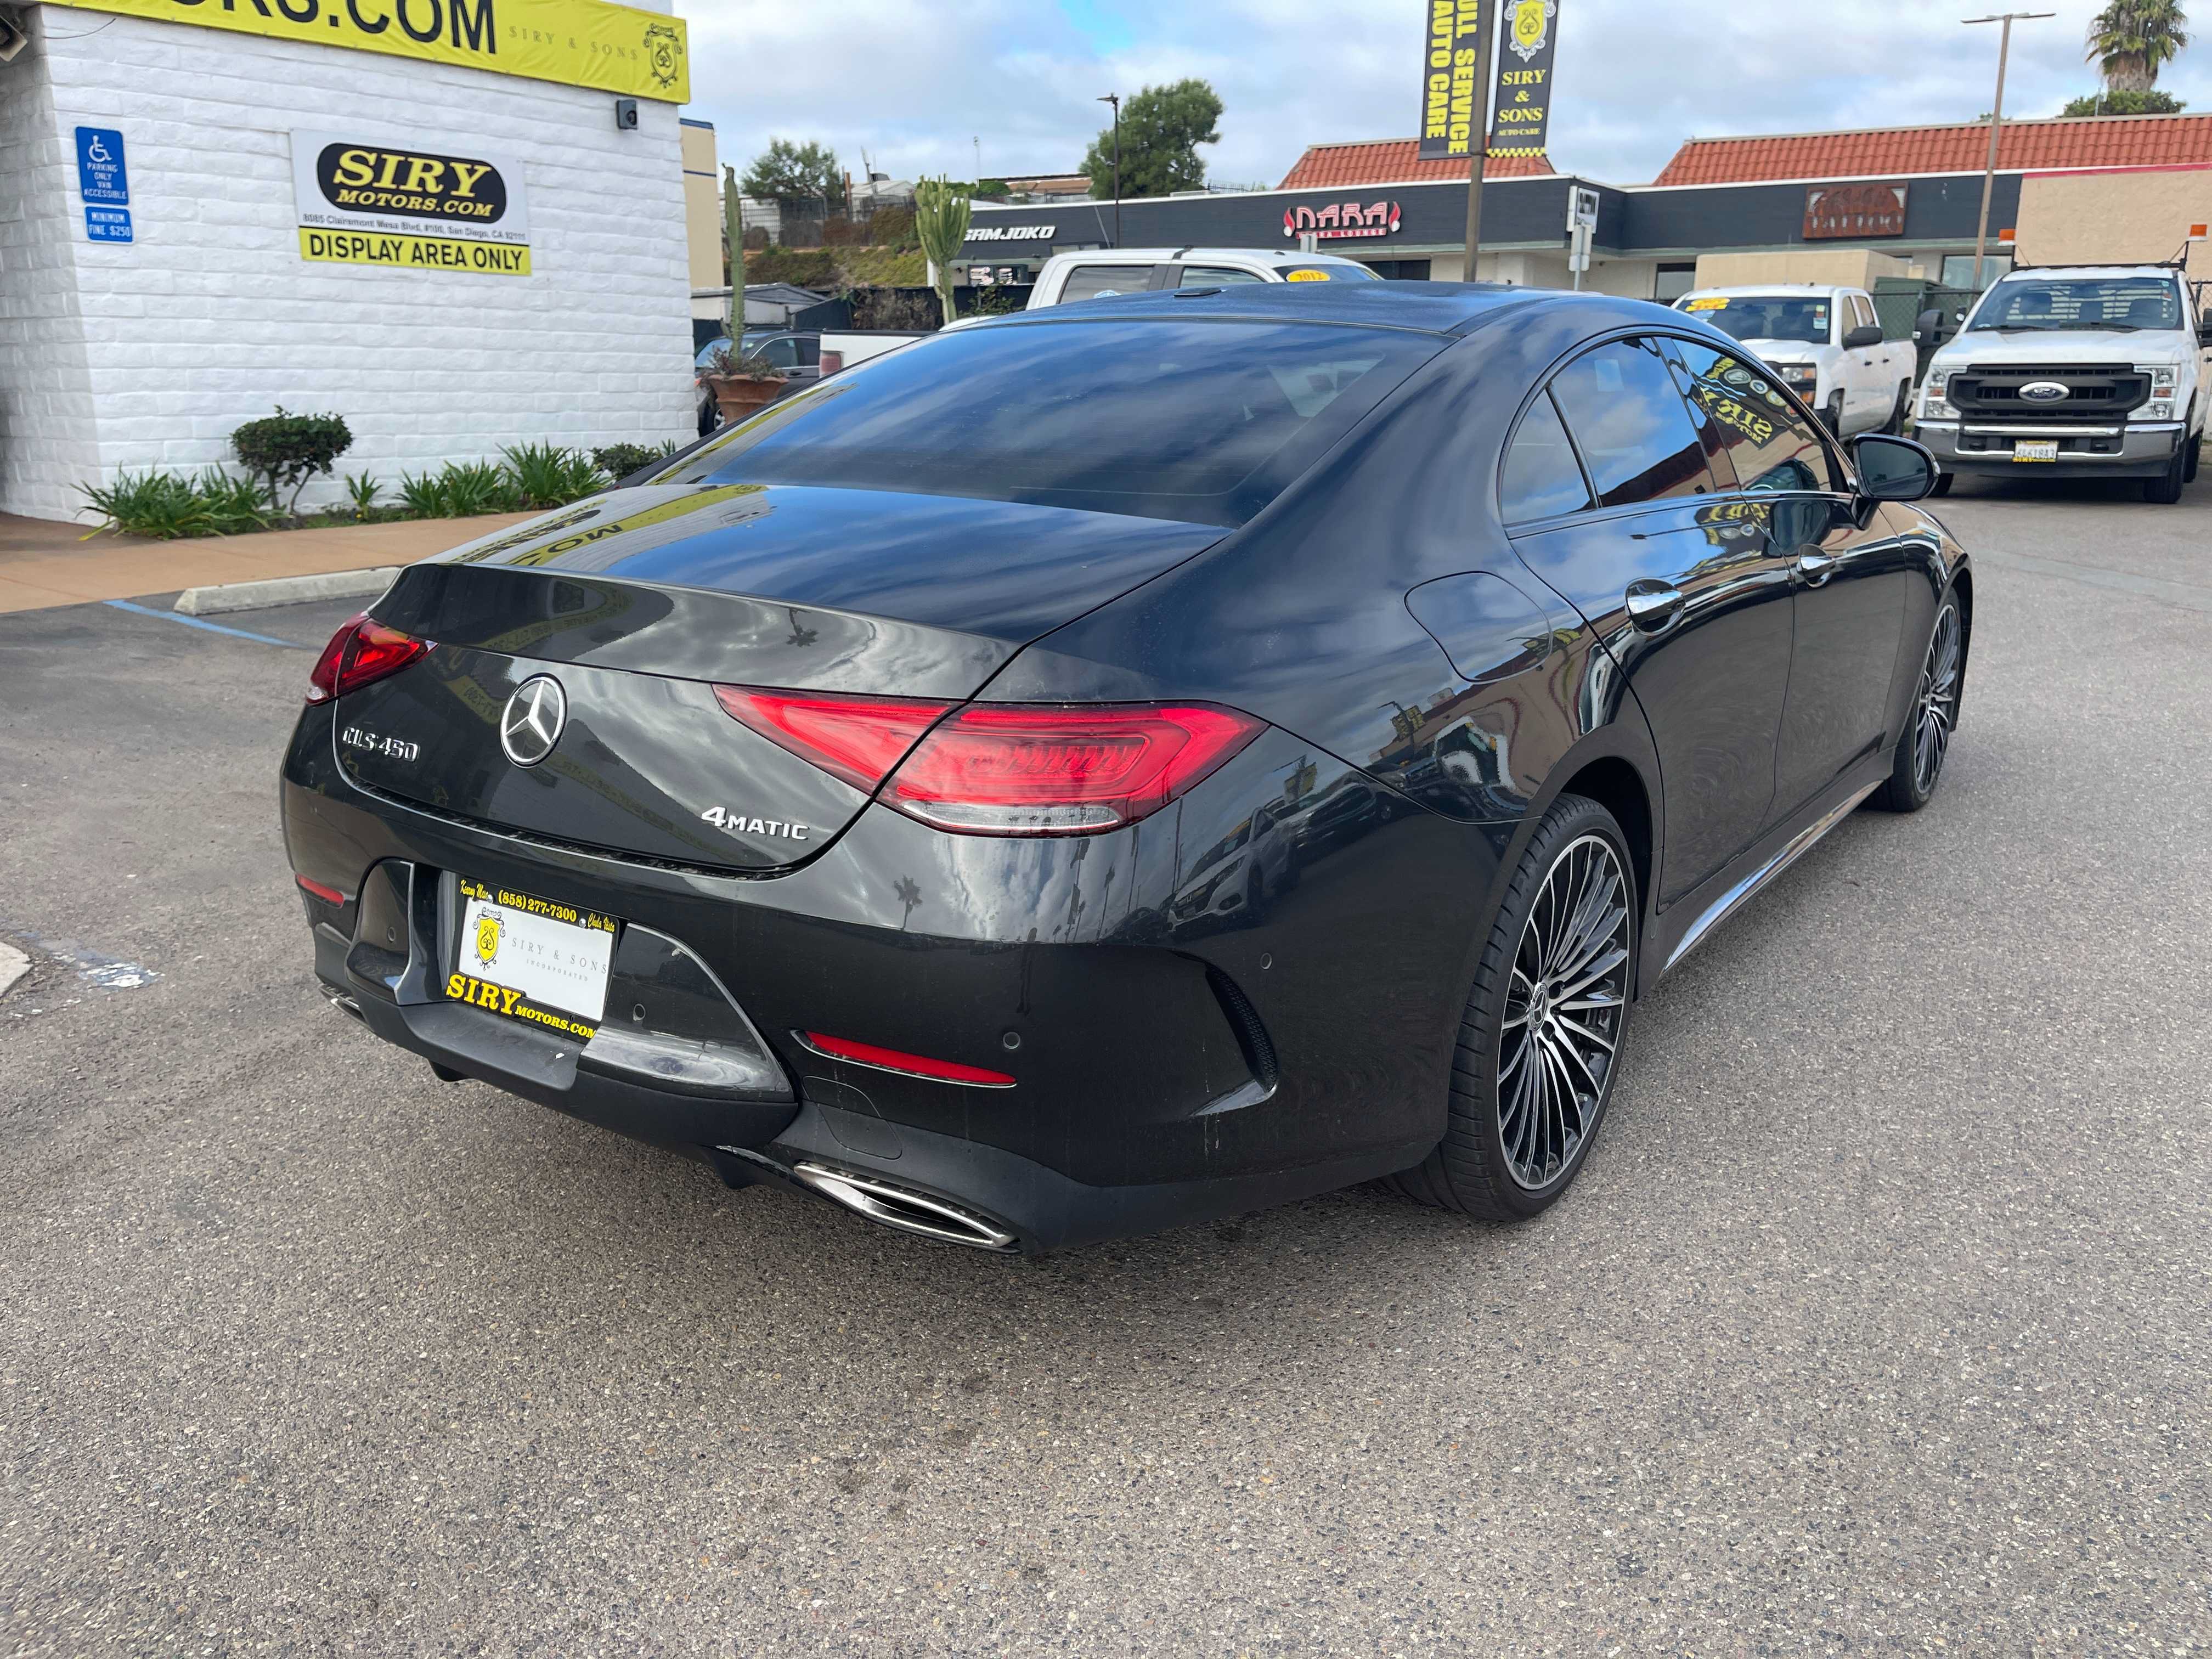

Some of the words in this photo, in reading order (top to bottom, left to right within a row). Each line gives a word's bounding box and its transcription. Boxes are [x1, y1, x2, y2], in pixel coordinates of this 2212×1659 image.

[1456, 0, 1478, 39] ULL
[509, 26, 555, 44] SIRY
[568, 37, 578, 49] &
[590, 41, 638, 60] SONS
[1430, 0, 1454, 68] AUTO
[1502, 69, 1546, 86] SIRY
[1426, 73, 1451, 139] CARE
[1448, 48, 1476, 154] SERVICE
[1515, 90, 1530, 103] &
[1498, 107, 1543, 123] SONS
[87, 162, 118, 173] PARKING
[94, 172, 112, 181] ONLY
[333, 150, 492, 198] SIRY
[84, 189, 127, 200] ACCESSIBLE
[335, 189, 494, 217] MOTORS.COM
[91, 211, 126, 224] MINIMUM
[1296, 201, 1388, 229] NARA
[88, 224, 106, 235] FINE
[109, 225, 132, 237] $250
[963, 225, 1056, 241] SAMJOKO
[1340, 228, 1386, 238] LOUNGE
[310, 234, 403, 261] DISPLAY
[412, 241, 467, 267] AREA
[474, 247, 522, 270] ONLY
[342, 726, 376, 751] CLS
[379, 737, 420, 762] 450
[701, 806, 810, 840] 4MATIC
[498, 889, 527, 910] (858)
[527, 898, 577, 922] 277-7300
[511, 937, 544, 955] SIRY
[553, 950, 560, 960] &
[570, 955, 607, 974] SONS
[526, 958, 588, 982] INCORPORATED
[446, 974, 521, 1015] SIRY
[514, 1005, 596, 1039] MOTORS.COM
